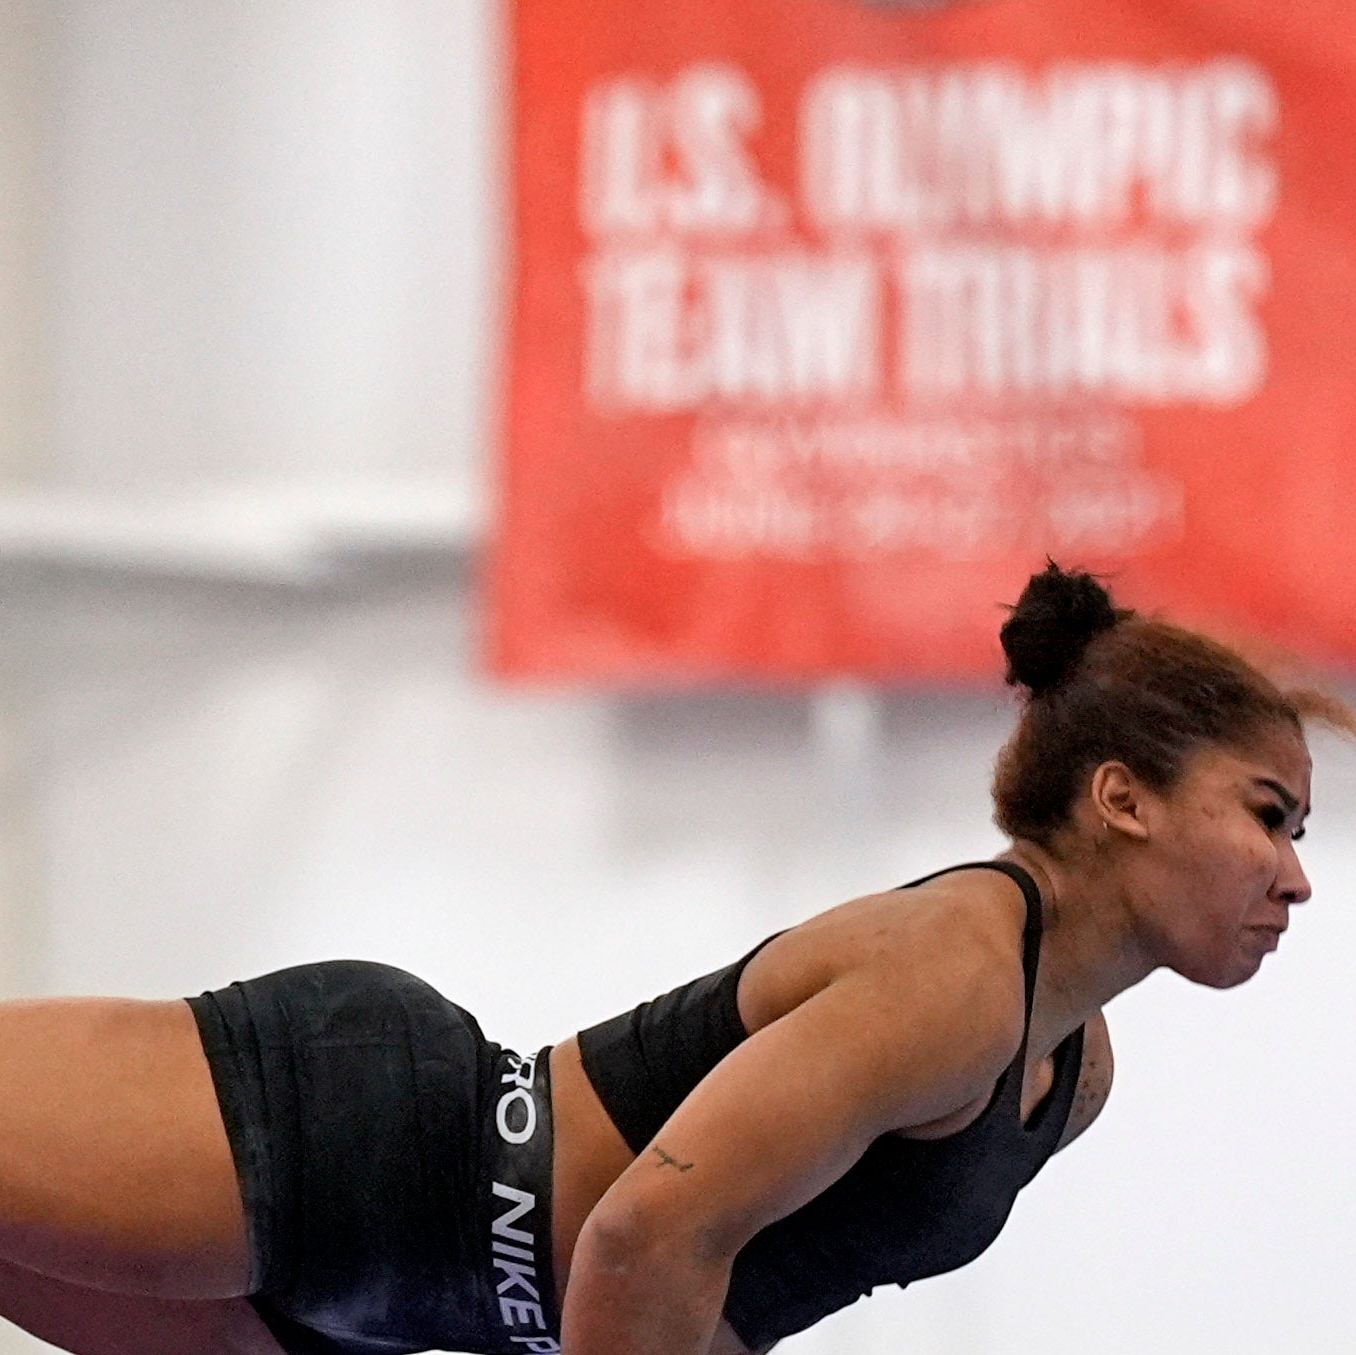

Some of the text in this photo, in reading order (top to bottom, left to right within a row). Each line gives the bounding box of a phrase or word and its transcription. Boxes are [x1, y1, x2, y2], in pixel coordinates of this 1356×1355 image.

[799, 58, 1279, 230] OLYMPIC
[581, 242, 1267, 410] TEAM TRIALS
[491, 1181, 547, 1331] NIKE
